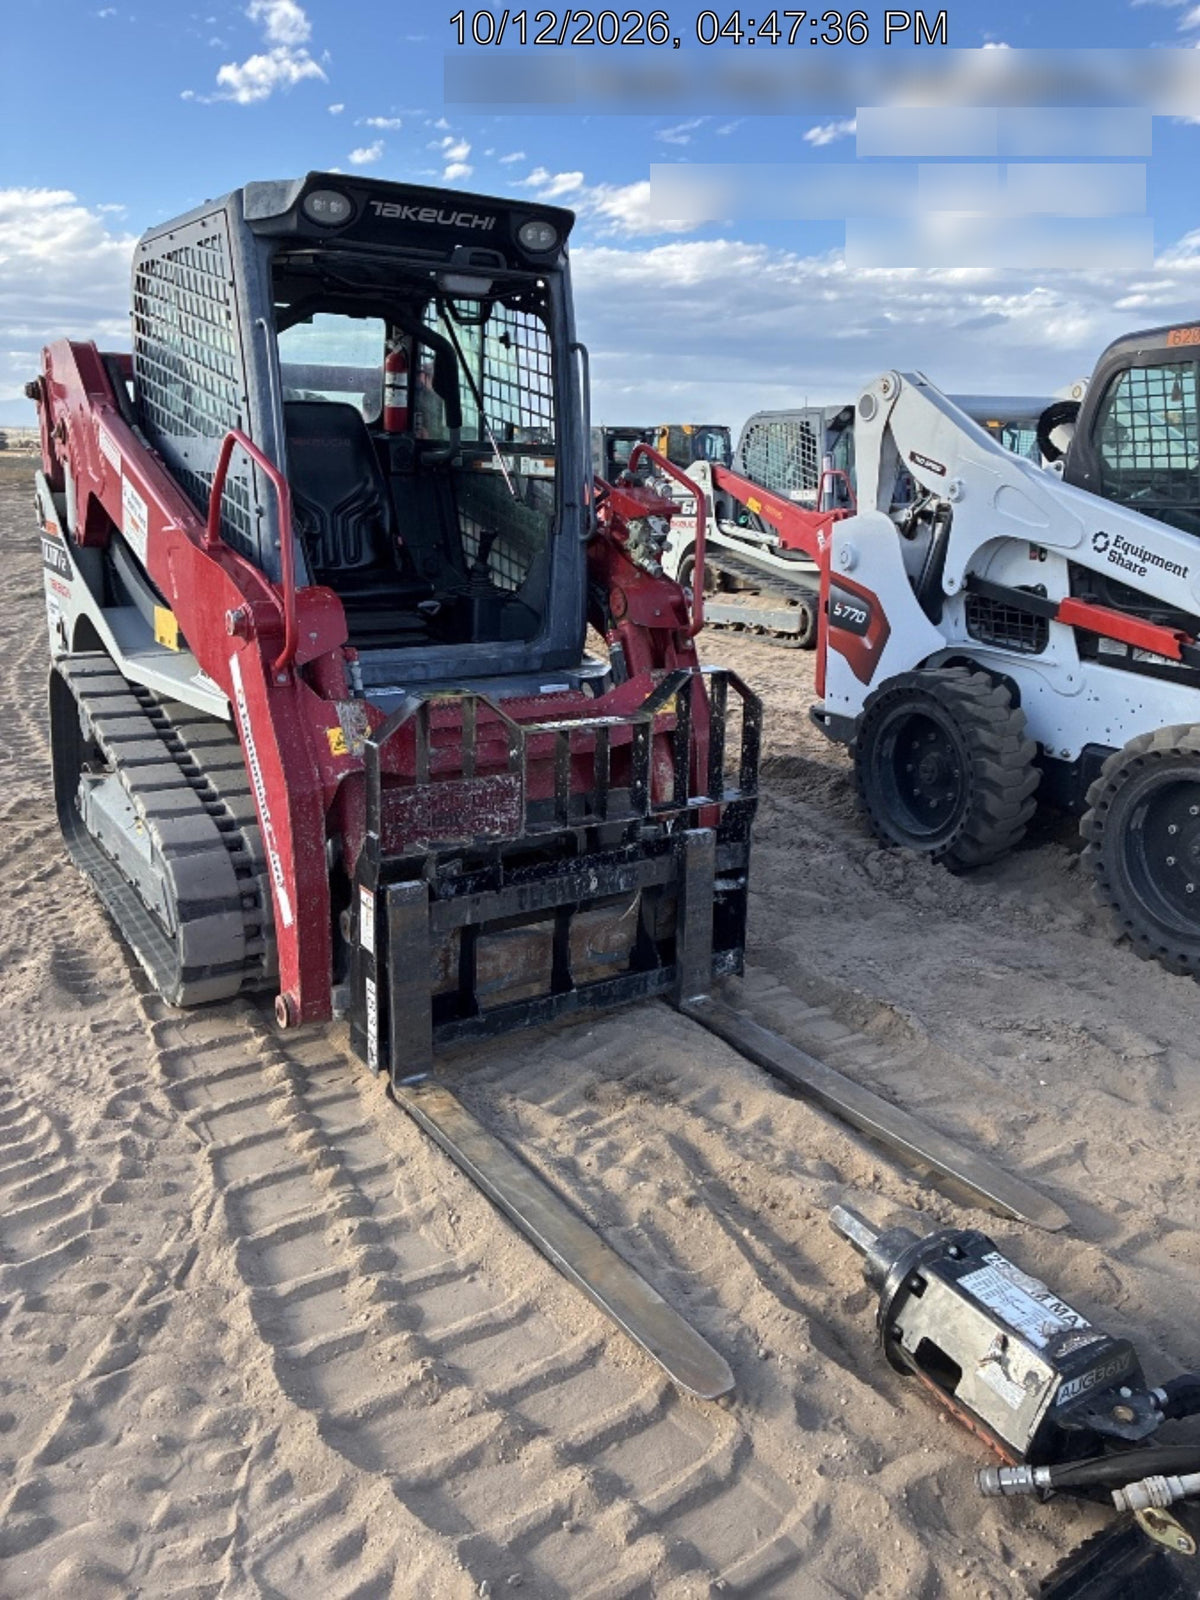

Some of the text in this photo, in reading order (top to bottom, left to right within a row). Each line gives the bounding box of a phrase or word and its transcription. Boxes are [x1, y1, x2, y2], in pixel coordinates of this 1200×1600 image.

[369, 200, 497, 230] TAKEUCHI
[1107, 549, 1148, 577] Share
[1113, 534, 1189, 579] Equipment
[833, 602, 867, 623] S770
